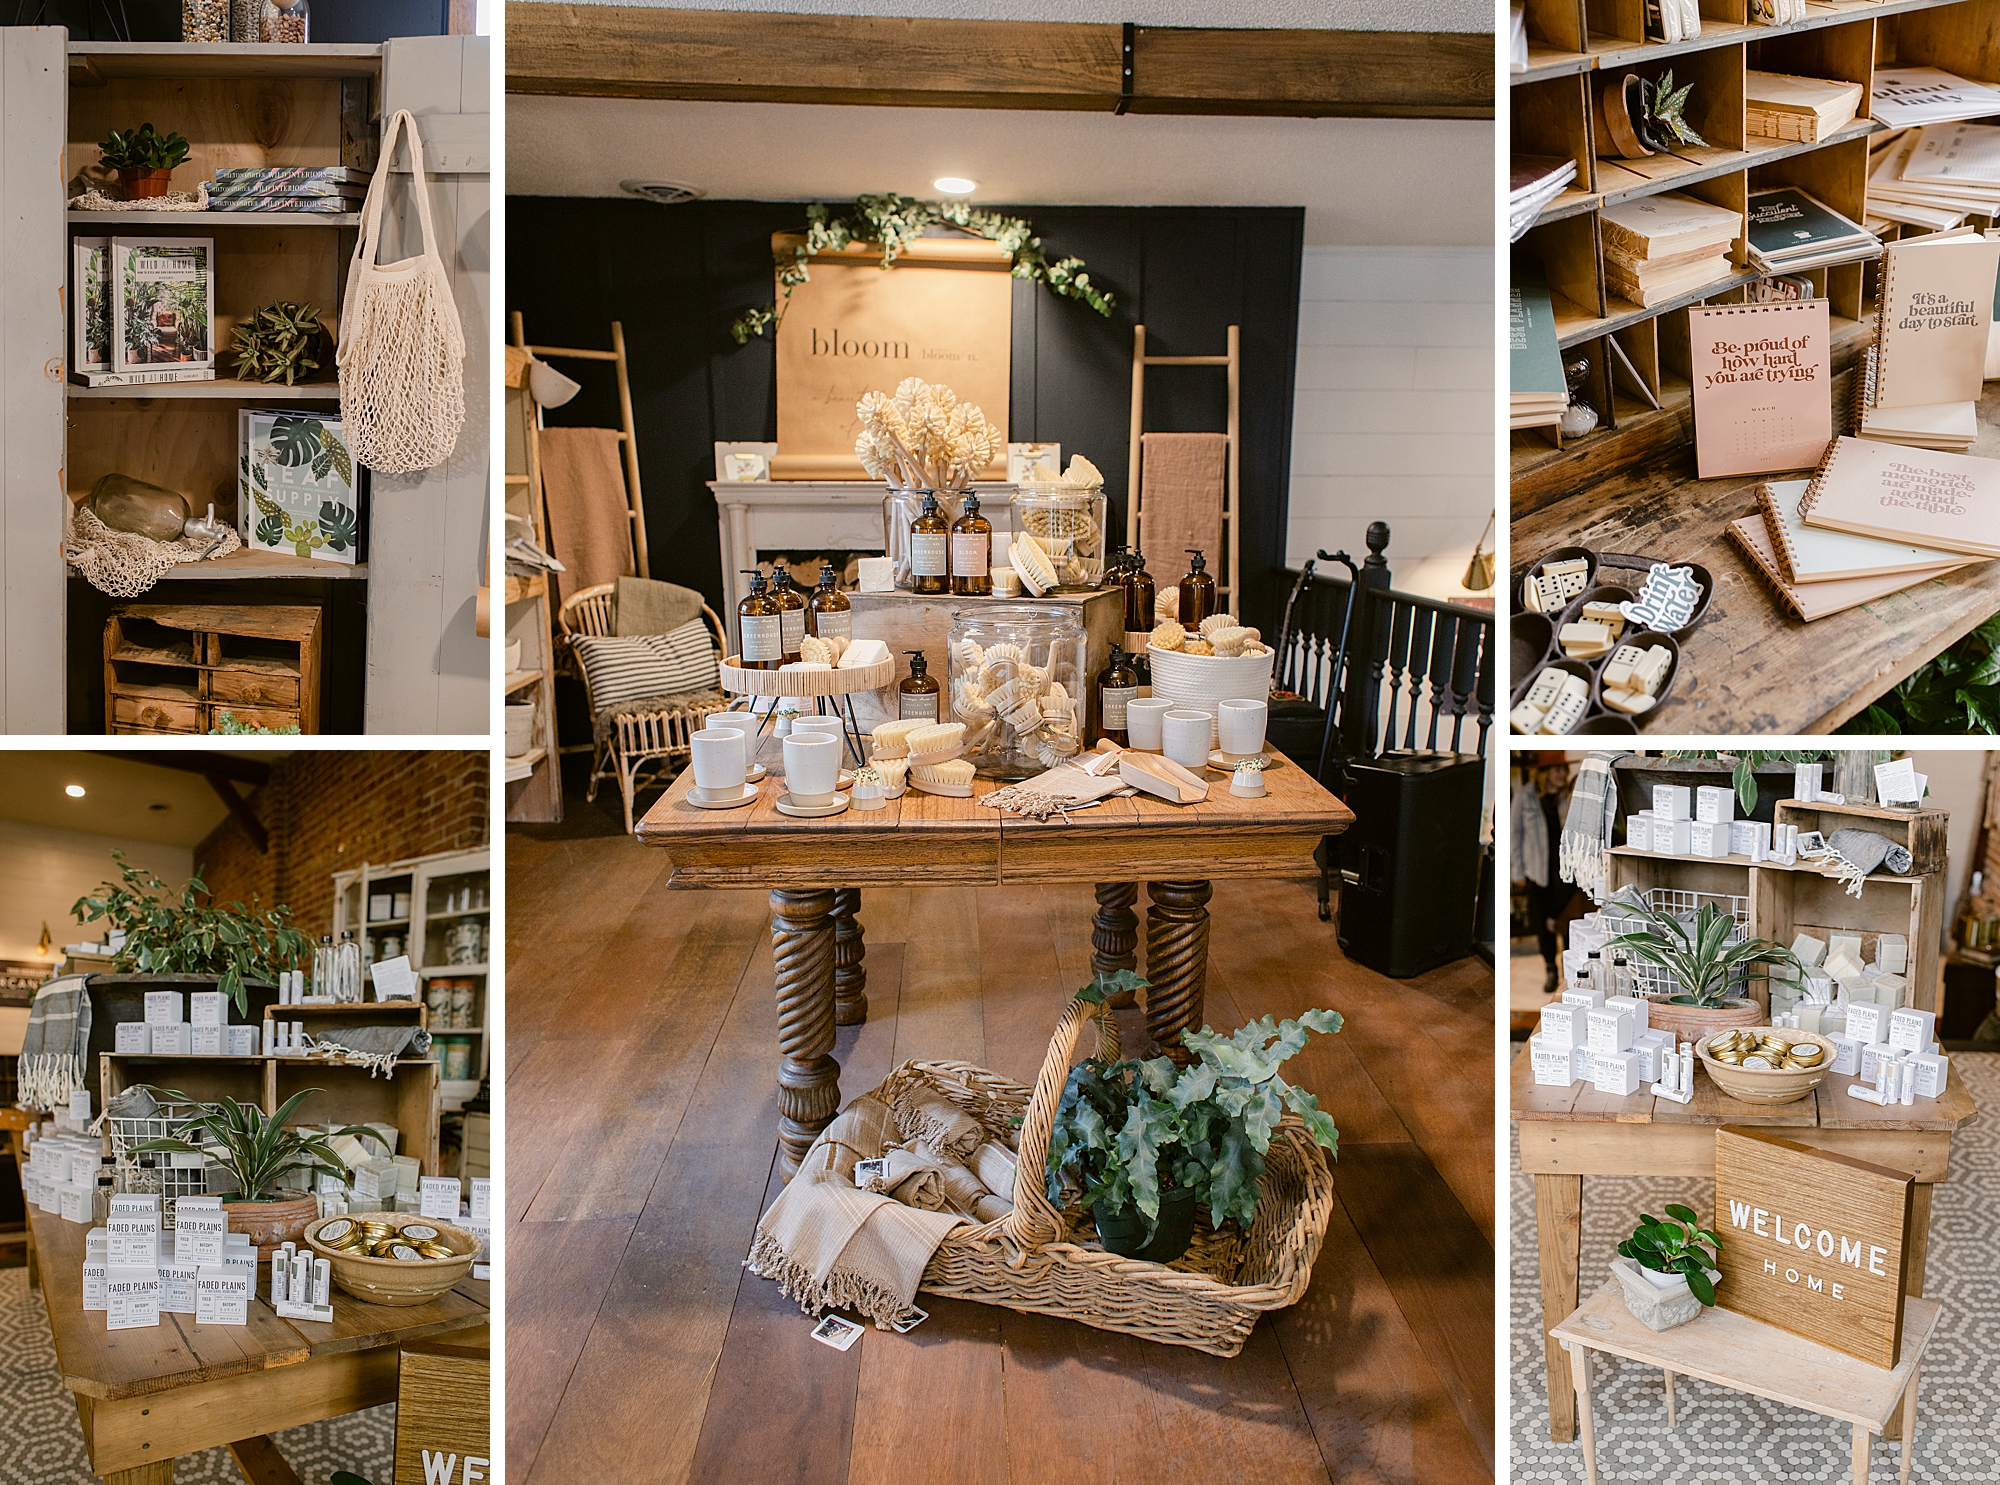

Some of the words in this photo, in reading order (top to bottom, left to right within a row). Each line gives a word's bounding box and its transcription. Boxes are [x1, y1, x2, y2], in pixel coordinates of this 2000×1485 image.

[1892, 94, 1963, 106] lady
[253, 184, 270, 192] WILD
[272, 184, 308, 192] INTERIORS
[282, 200, 320, 208] INTERIORS
[140, 260, 158, 270] WILD
[162, 260, 170, 268] AT
[172, 260, 192, 269] HOME
[1510, 287, 1524, 322] PLANNER
[1912, 292, 1936, 306] It's
[1938, 294, 1948, 304] a
[1909, 300, 1975, 316] beautiful
[1898, 317, 1926, 332] day
[1928, 316, 1942, 330] to
[1944, 314, 1978, 328] start
[811, 328, 910, 360] bloom
[1510, 326, 1527, 350] DESK
[1712, 342, 1741, 354] Be
[1744, 337, 1796, 356] proud
[1792, 335, 1810, 349] of
[1722, 355, 1760, 372] how
[1763, 352, 1802, 368] hard
[129, 374, 146, 384] WILD
[149, 374, 157, 382] AT
[160, 372, 178, 382] HOME
[1705, 371, 1738, 389] you
[1740, 368, 1764, 382] are
[1766, 364, 1819, 383] trying
[265, 463, 340, 489] LEAF
[1888, 462, 1928, 475] The
[1929, 468, 1972, 484] best
[1880, 470, 1976, 492] memories
[1881, 480, 1911, 489] are
[1914, 484, 1972, 498] made
[264, 488, 340, 510] SUPPLY
[1890, 489, 1958, 505] around
[1880, 496, 1914, 508] the
[1916, 501, 1966, 516] table
[1629, 566, 1682, 623] Drink
[1542, 1011, 1555, 1019] FADED
[1556, 1013, 1572, 1022] PLAINS
[1848, 1007, 1861, 1016] FADED
[1863, 1010, 1878, 1020] PLAINS
[1588, 1015, 1601, 1024] FADED
[1603, 1018, 1616, 1027] PLAINS
[1892, 1014, 1905, 1022] FADED
[1906, 1018, 1922, 1027] PLAINS
[1838, 1044, 1853, 1052] PLAINS
[1595, 1060, 1608, 1068] FADED
[1610, 1063, 1625, 1071] PLAINS
[1920, 1063, 1936, 1072] PLAINS
[441, 1184, 460, 1192] PLAINS
[112, 1204, 130, 1212] FADED
[108, 1224, 130, 1232] FADED
[132, 1224, 156, 1232] PLAINS
[176, 1221, 196, 1230] FADED
[198, 1222, 222, 1232] PLAINS
[1730, 1200, 1888, 1276] WELCOME
[84, 1268, 105, 1276] FADED
[158, 1269, 170, 1278] DED
[172, 1270, 196, 1280] PLAINS
[198, 1280, 220, 1290] FADED
[222, 1280, 246, 1290] PLAINS
[1764, 1258, 1844, 1300] HOME
[109, 1283, 130, 1292] FADED
[134, 1281, 158, 1290] PLAINS
